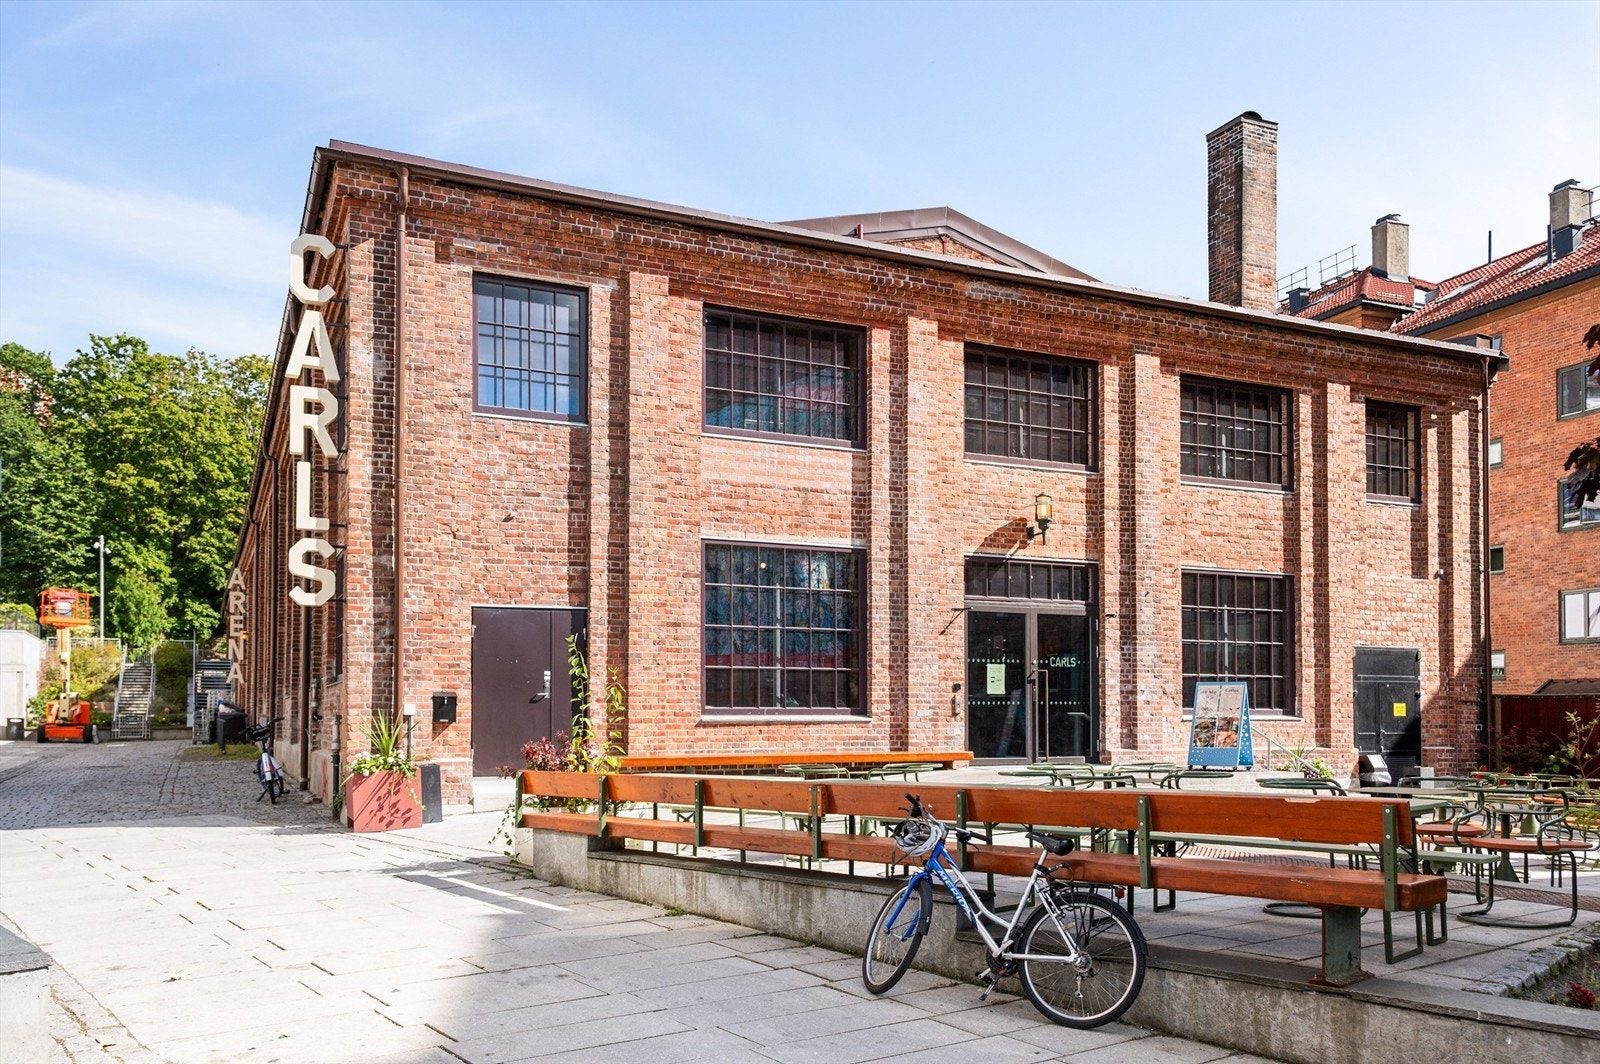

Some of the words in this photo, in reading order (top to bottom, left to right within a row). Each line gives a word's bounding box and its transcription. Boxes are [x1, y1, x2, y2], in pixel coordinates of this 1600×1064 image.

[285, 233, 340, 607] CARLS
[226, 567, 246, 685] ARENA
[1049, 656, 1077, 668] CARLS
